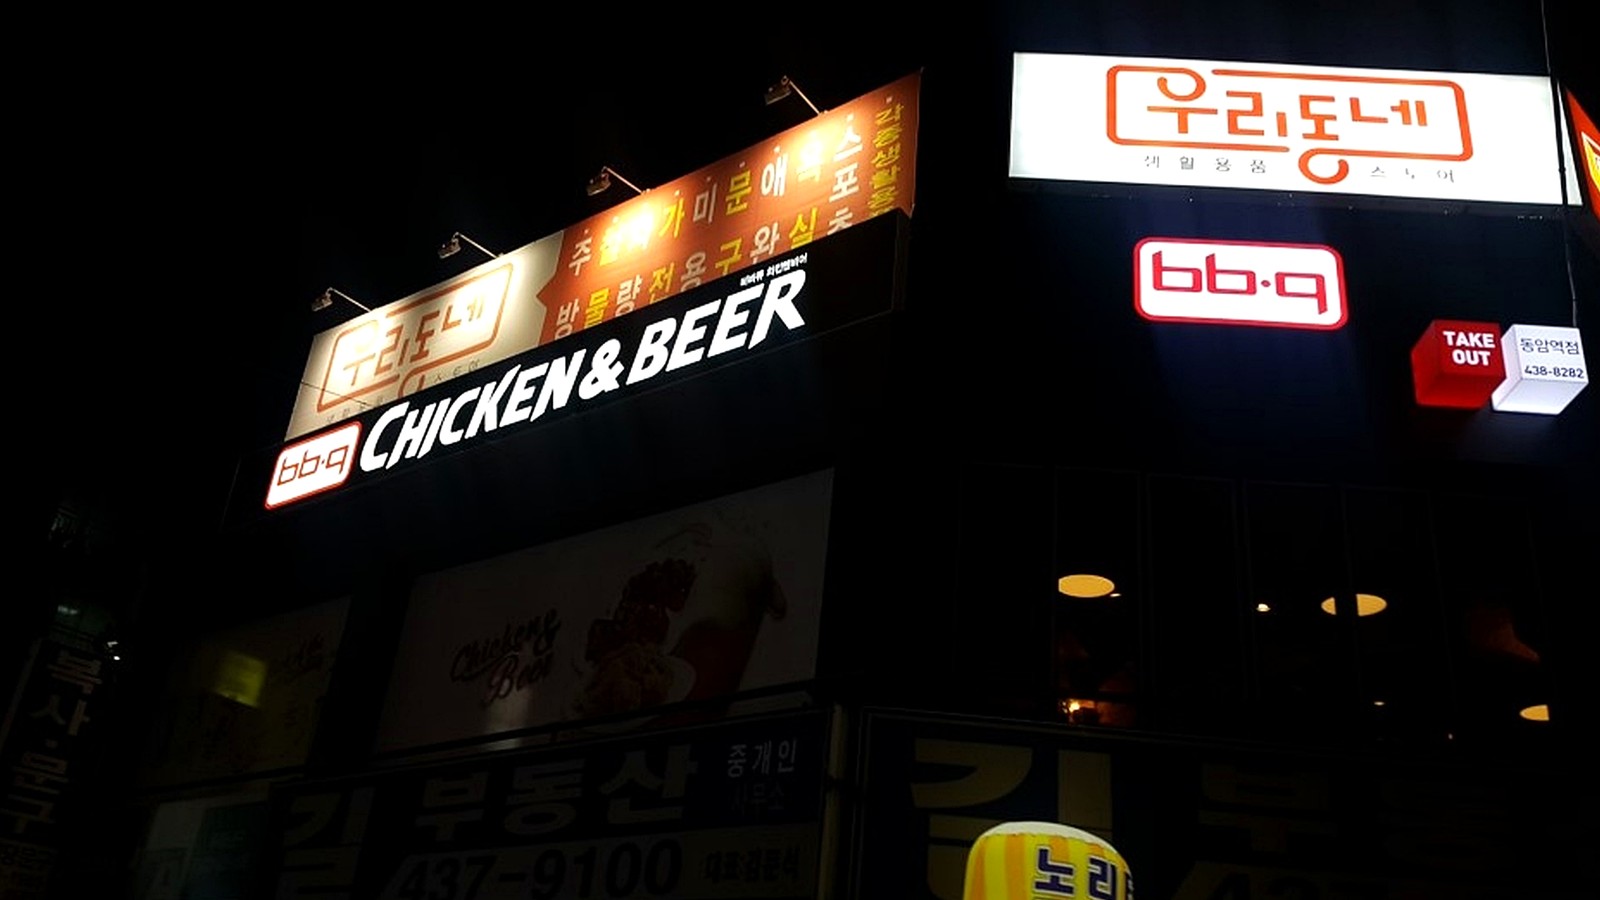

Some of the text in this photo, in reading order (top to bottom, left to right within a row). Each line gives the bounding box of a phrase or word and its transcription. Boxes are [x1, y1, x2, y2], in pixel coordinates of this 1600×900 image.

[1147, 66, 1428, 185] 우리동네
[680, 183, 717, 293] 미용
[715, 170, 754, 275] 문구
[553, 235, 594, 342] 주방
[1442, 331, 1496, 349] TAKE
[1452, 349, 1491, 367] OUT
[1519, 338, 1581, 356] 동암역점
[1523, 365, 1585, 379] 438-8282
[726, 739, 798, 780] 중개인
[415, 743, 699, 842] 부동산
[399, 839, 684, 900] 437-9100
